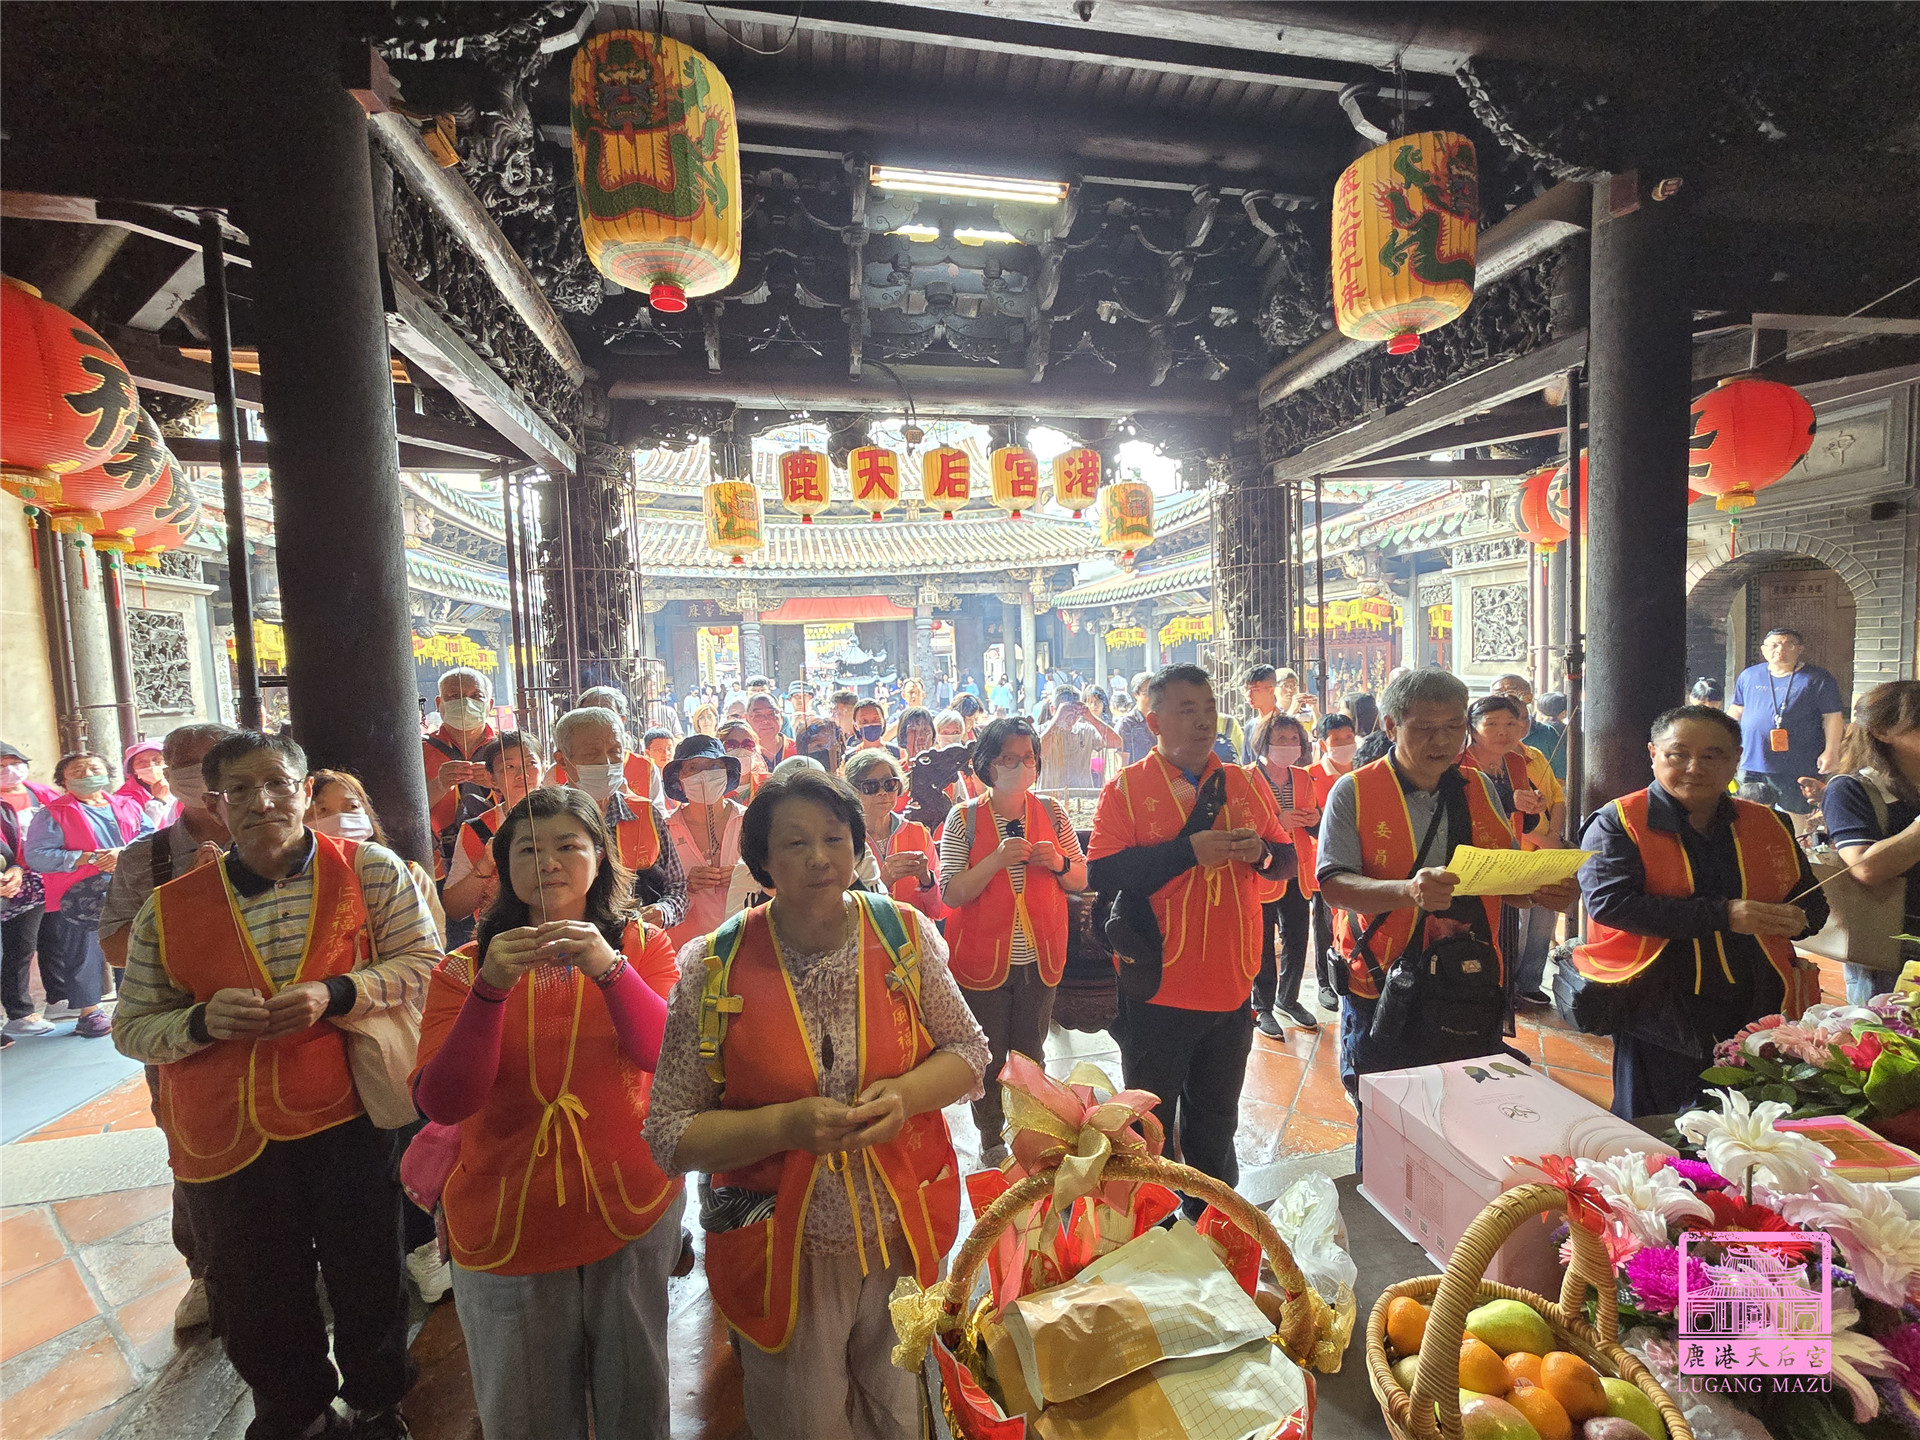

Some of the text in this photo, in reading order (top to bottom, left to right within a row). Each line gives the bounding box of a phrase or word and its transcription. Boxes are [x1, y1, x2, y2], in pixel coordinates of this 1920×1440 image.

[782, 451, 824, 502] 鹿
[857, 450, 898, 500] 天
[932, 450, 971, 499] 后
[1003, 452, 1038, 498] 宮
[1064, 449, 1101, 498] 港
[1142, 796, 1163, 839] 會長
[1373, 820, 1392, 868] 委員
